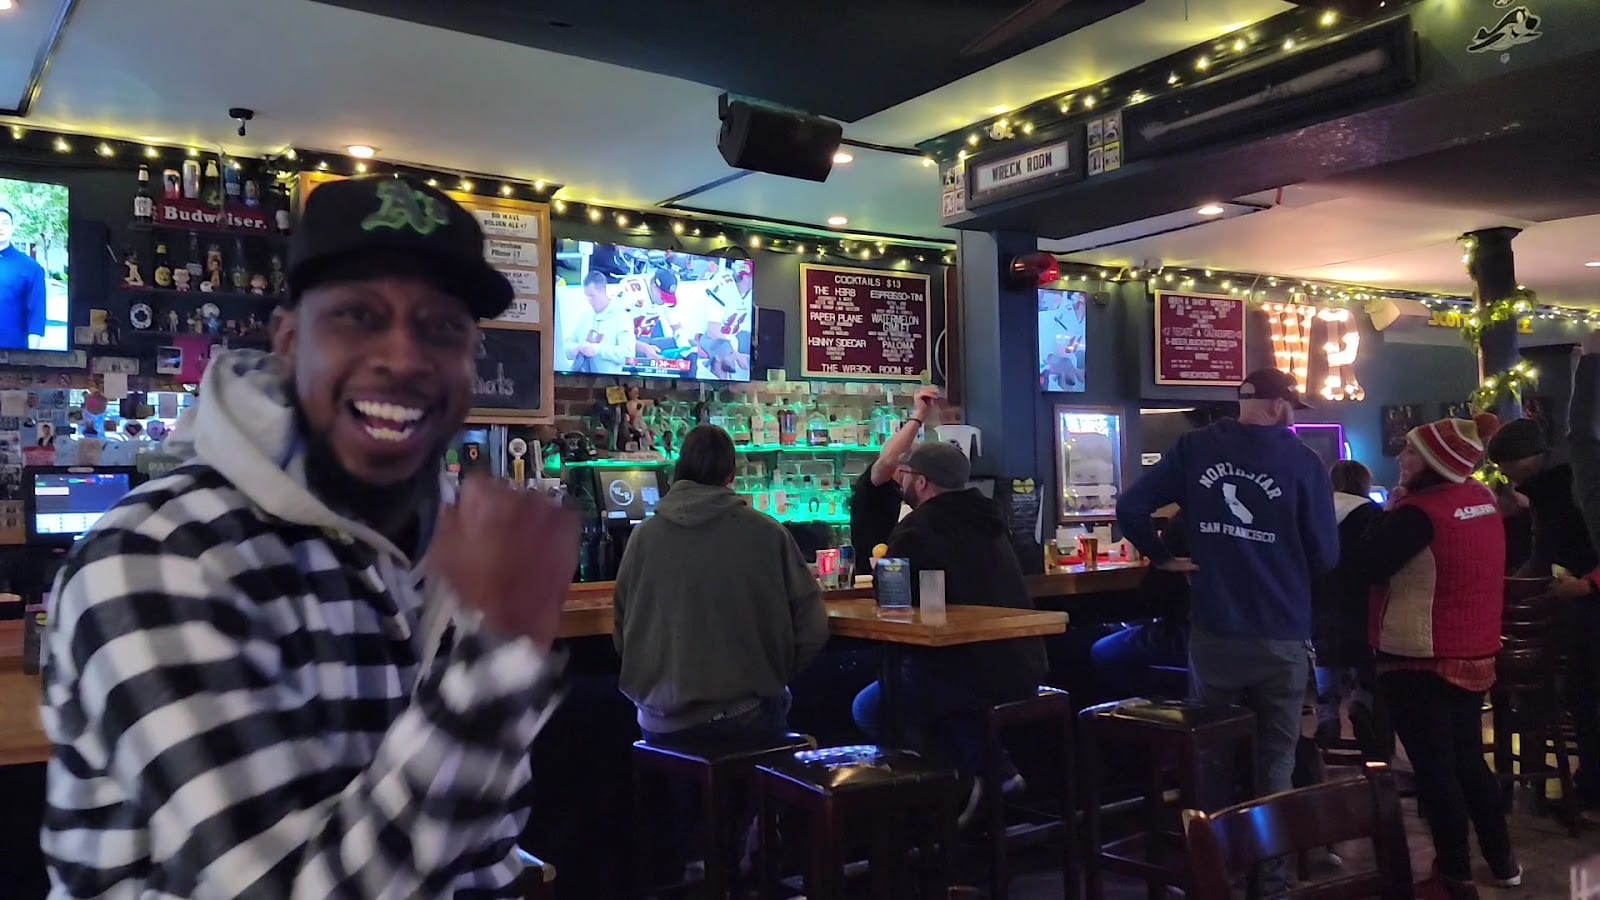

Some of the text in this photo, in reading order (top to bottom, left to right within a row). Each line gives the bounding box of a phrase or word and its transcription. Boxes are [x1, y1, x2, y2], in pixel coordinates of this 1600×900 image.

[991, 151, 1053, 183] WRECK ROOM
[834, 275, 902, 289] COCKTAILS $13
[813, 285, 829, 296] THE
[810, 311, 864, 324] PAPER PLANE
[871, 313, 920, 325] WATERMELON
[835, 339, 867, 348] SIDECAR
[882, 340, 914, 350] PALOMA
[822, 363, 839, 372] THE
[879, 365, 902, 375] ROOM
[1199, 521, 1276, 544] SAN FRANCISCO
